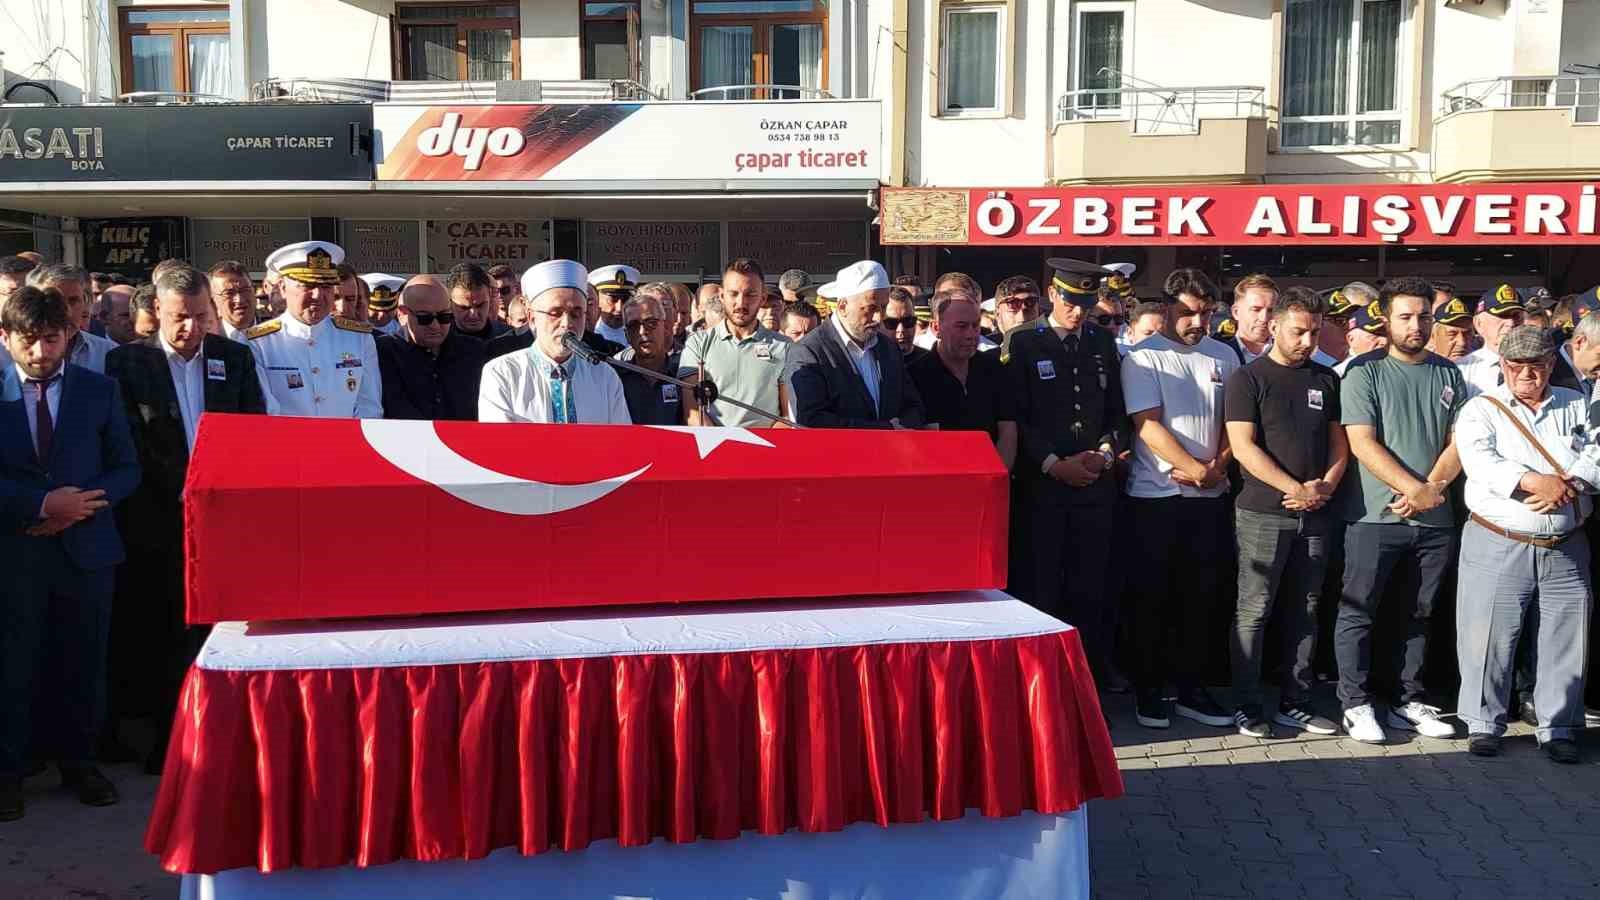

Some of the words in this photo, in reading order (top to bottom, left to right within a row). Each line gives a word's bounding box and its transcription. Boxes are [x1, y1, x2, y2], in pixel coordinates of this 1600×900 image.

[760, 118, 802, 130] ÖZKAN
[805, 120, 848, 132] ÇAPAR
[226, 137, 272, 151] ÇAPAR
[275, 134, 334, 148] TİCARET
[417, 112, 525, 170] dyo
[768, 133, 791, 142] 0534
[71, 160, 105, 171] BOYA
[735, 152, 792, 172] çapar
[797, 148, 868, 168] ticaret
[976, 191, 1212, 236] ÖZBEK
[1244, 184, 1600, 242] ALIŞVERİ
[447, 222, 528, 243] ÇAPAR
[105, 248, 150, 263] APT.
[448, 241, 528, 260] TİCARET
